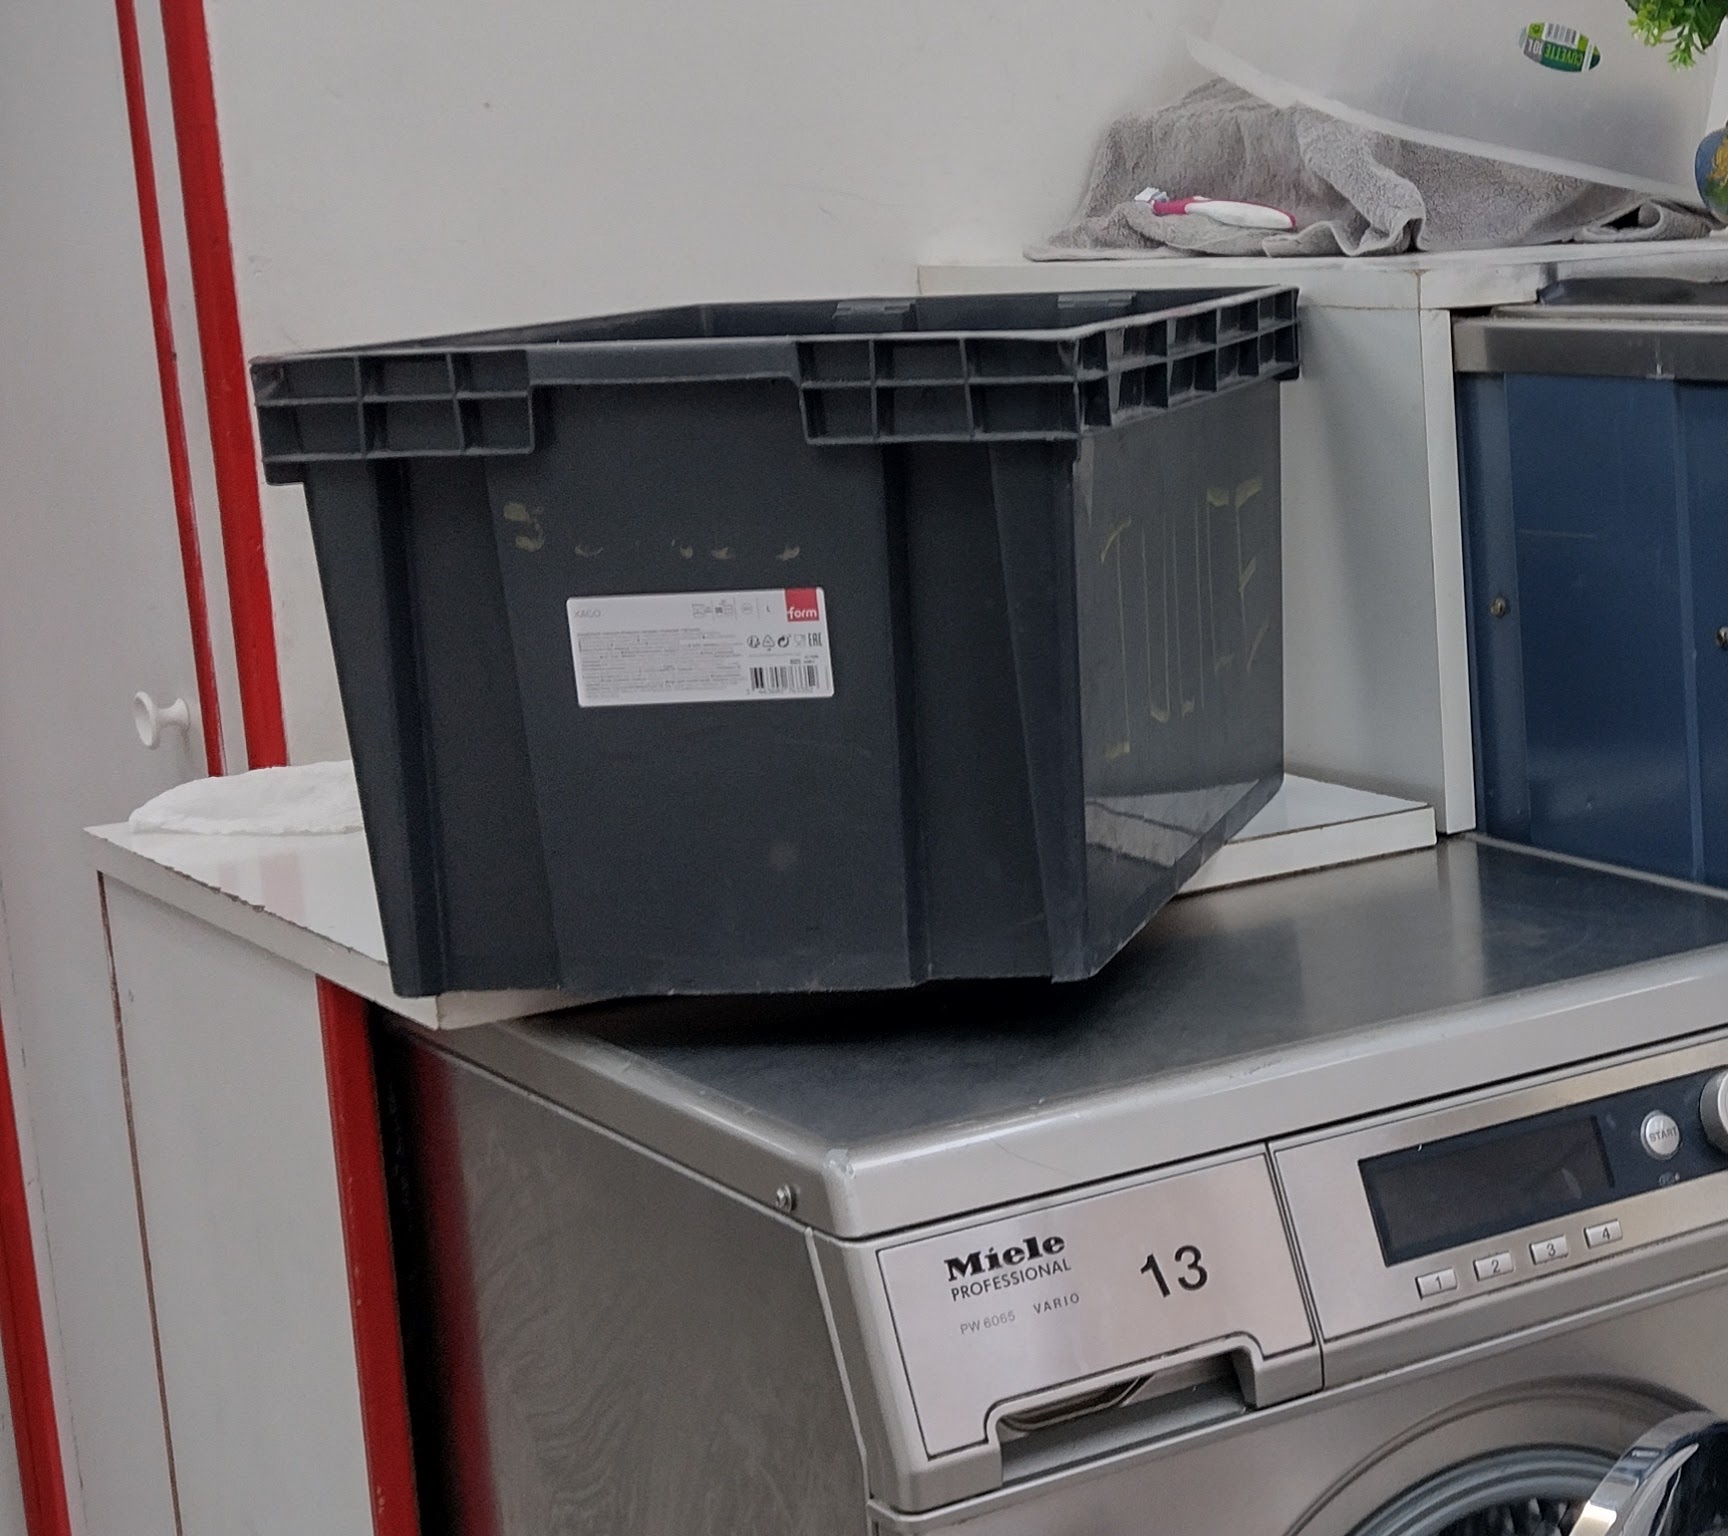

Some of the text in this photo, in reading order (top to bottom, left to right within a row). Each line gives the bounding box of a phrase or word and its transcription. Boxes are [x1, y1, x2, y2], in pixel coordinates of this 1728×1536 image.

[788, 606, 818, 619] form
[1648, 1125, 1680, 1144] START
[1601, 1227, 1611, 1241] 4
[943, 1232, 1066, 1283] Miele
[1545, 1242, 1557, 1257] 3
[1139, 1244, 1209, 1299] 13
[1491, 1259, 1501, 1274] 2
[950, 1257, 1072, 1302] PROFESSIONAL
[1434, 1275, 1443, 1290] 1
[959, 1319, 982, 1336] PW
[1032, 1292, 1081, 1316] VARIO
